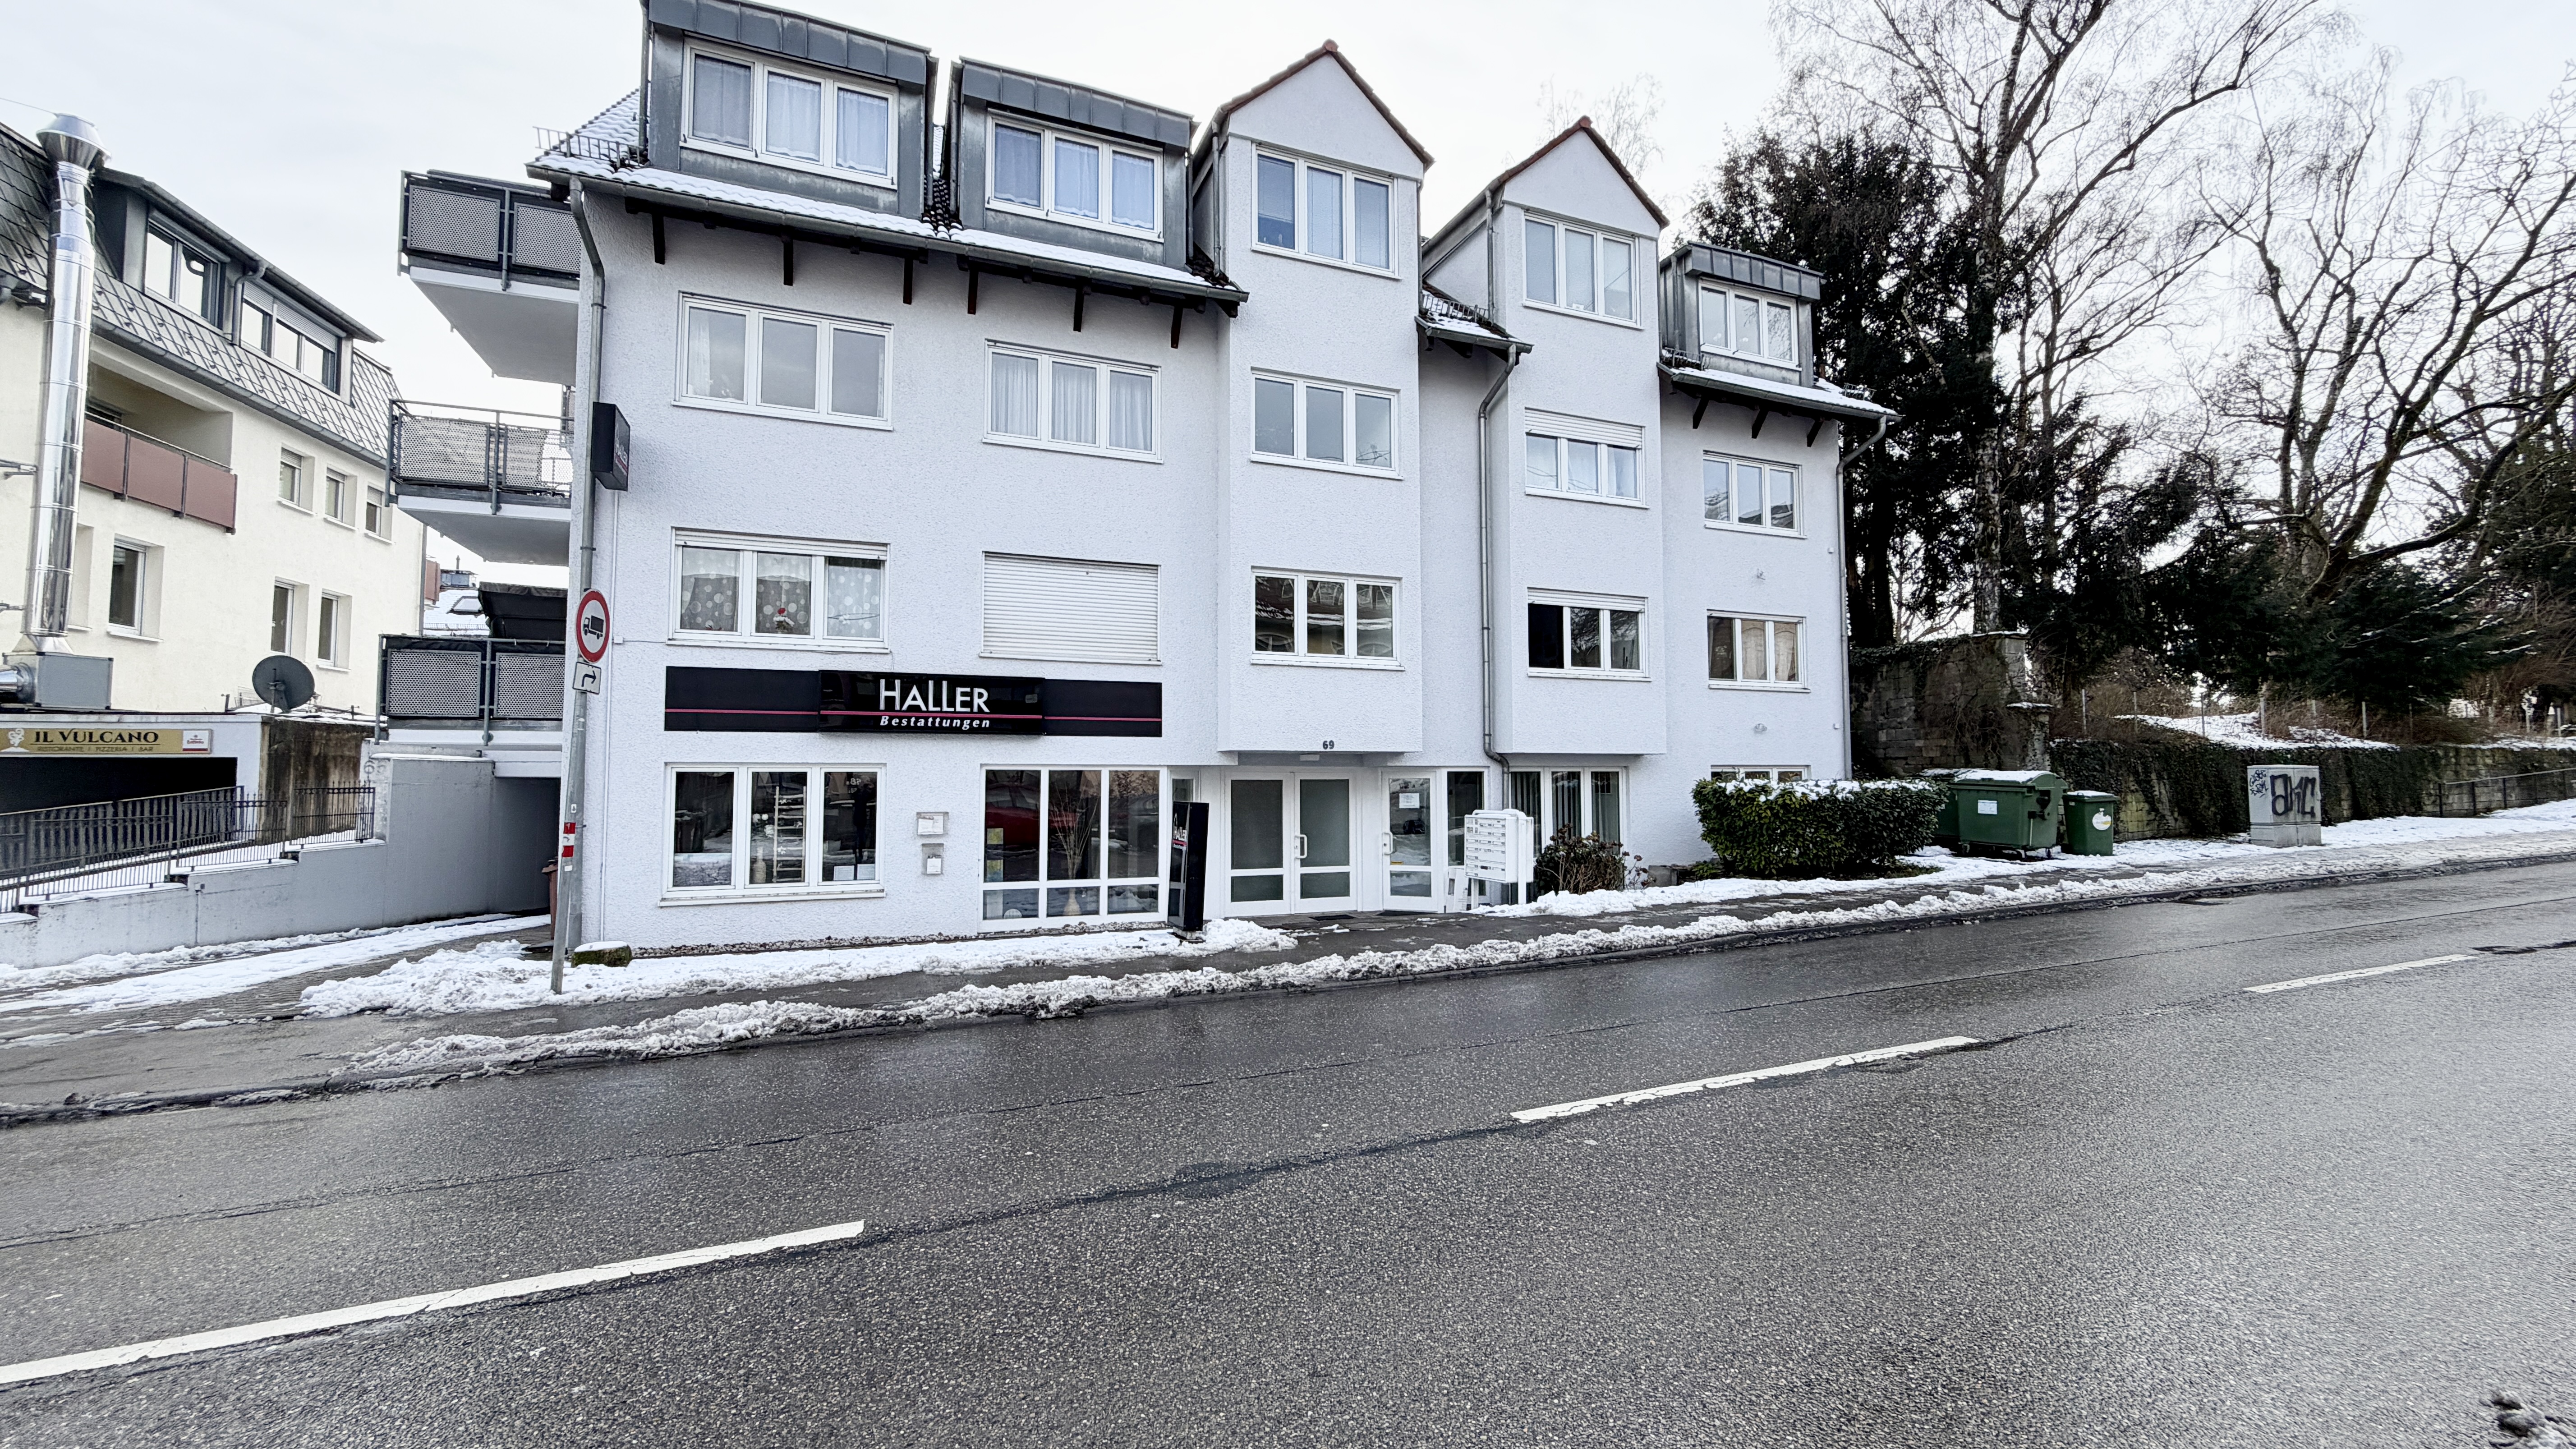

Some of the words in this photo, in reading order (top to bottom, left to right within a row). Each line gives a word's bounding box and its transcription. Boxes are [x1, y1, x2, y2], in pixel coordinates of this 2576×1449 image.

[879, 679, 990, 713] HALLER
[880, 716, 990, 730] Bestattungen
[34, 731, 53, 743] IL
[58, 728, 159, 743] VULCANO
[1323, 740, 1334, 750] 69
